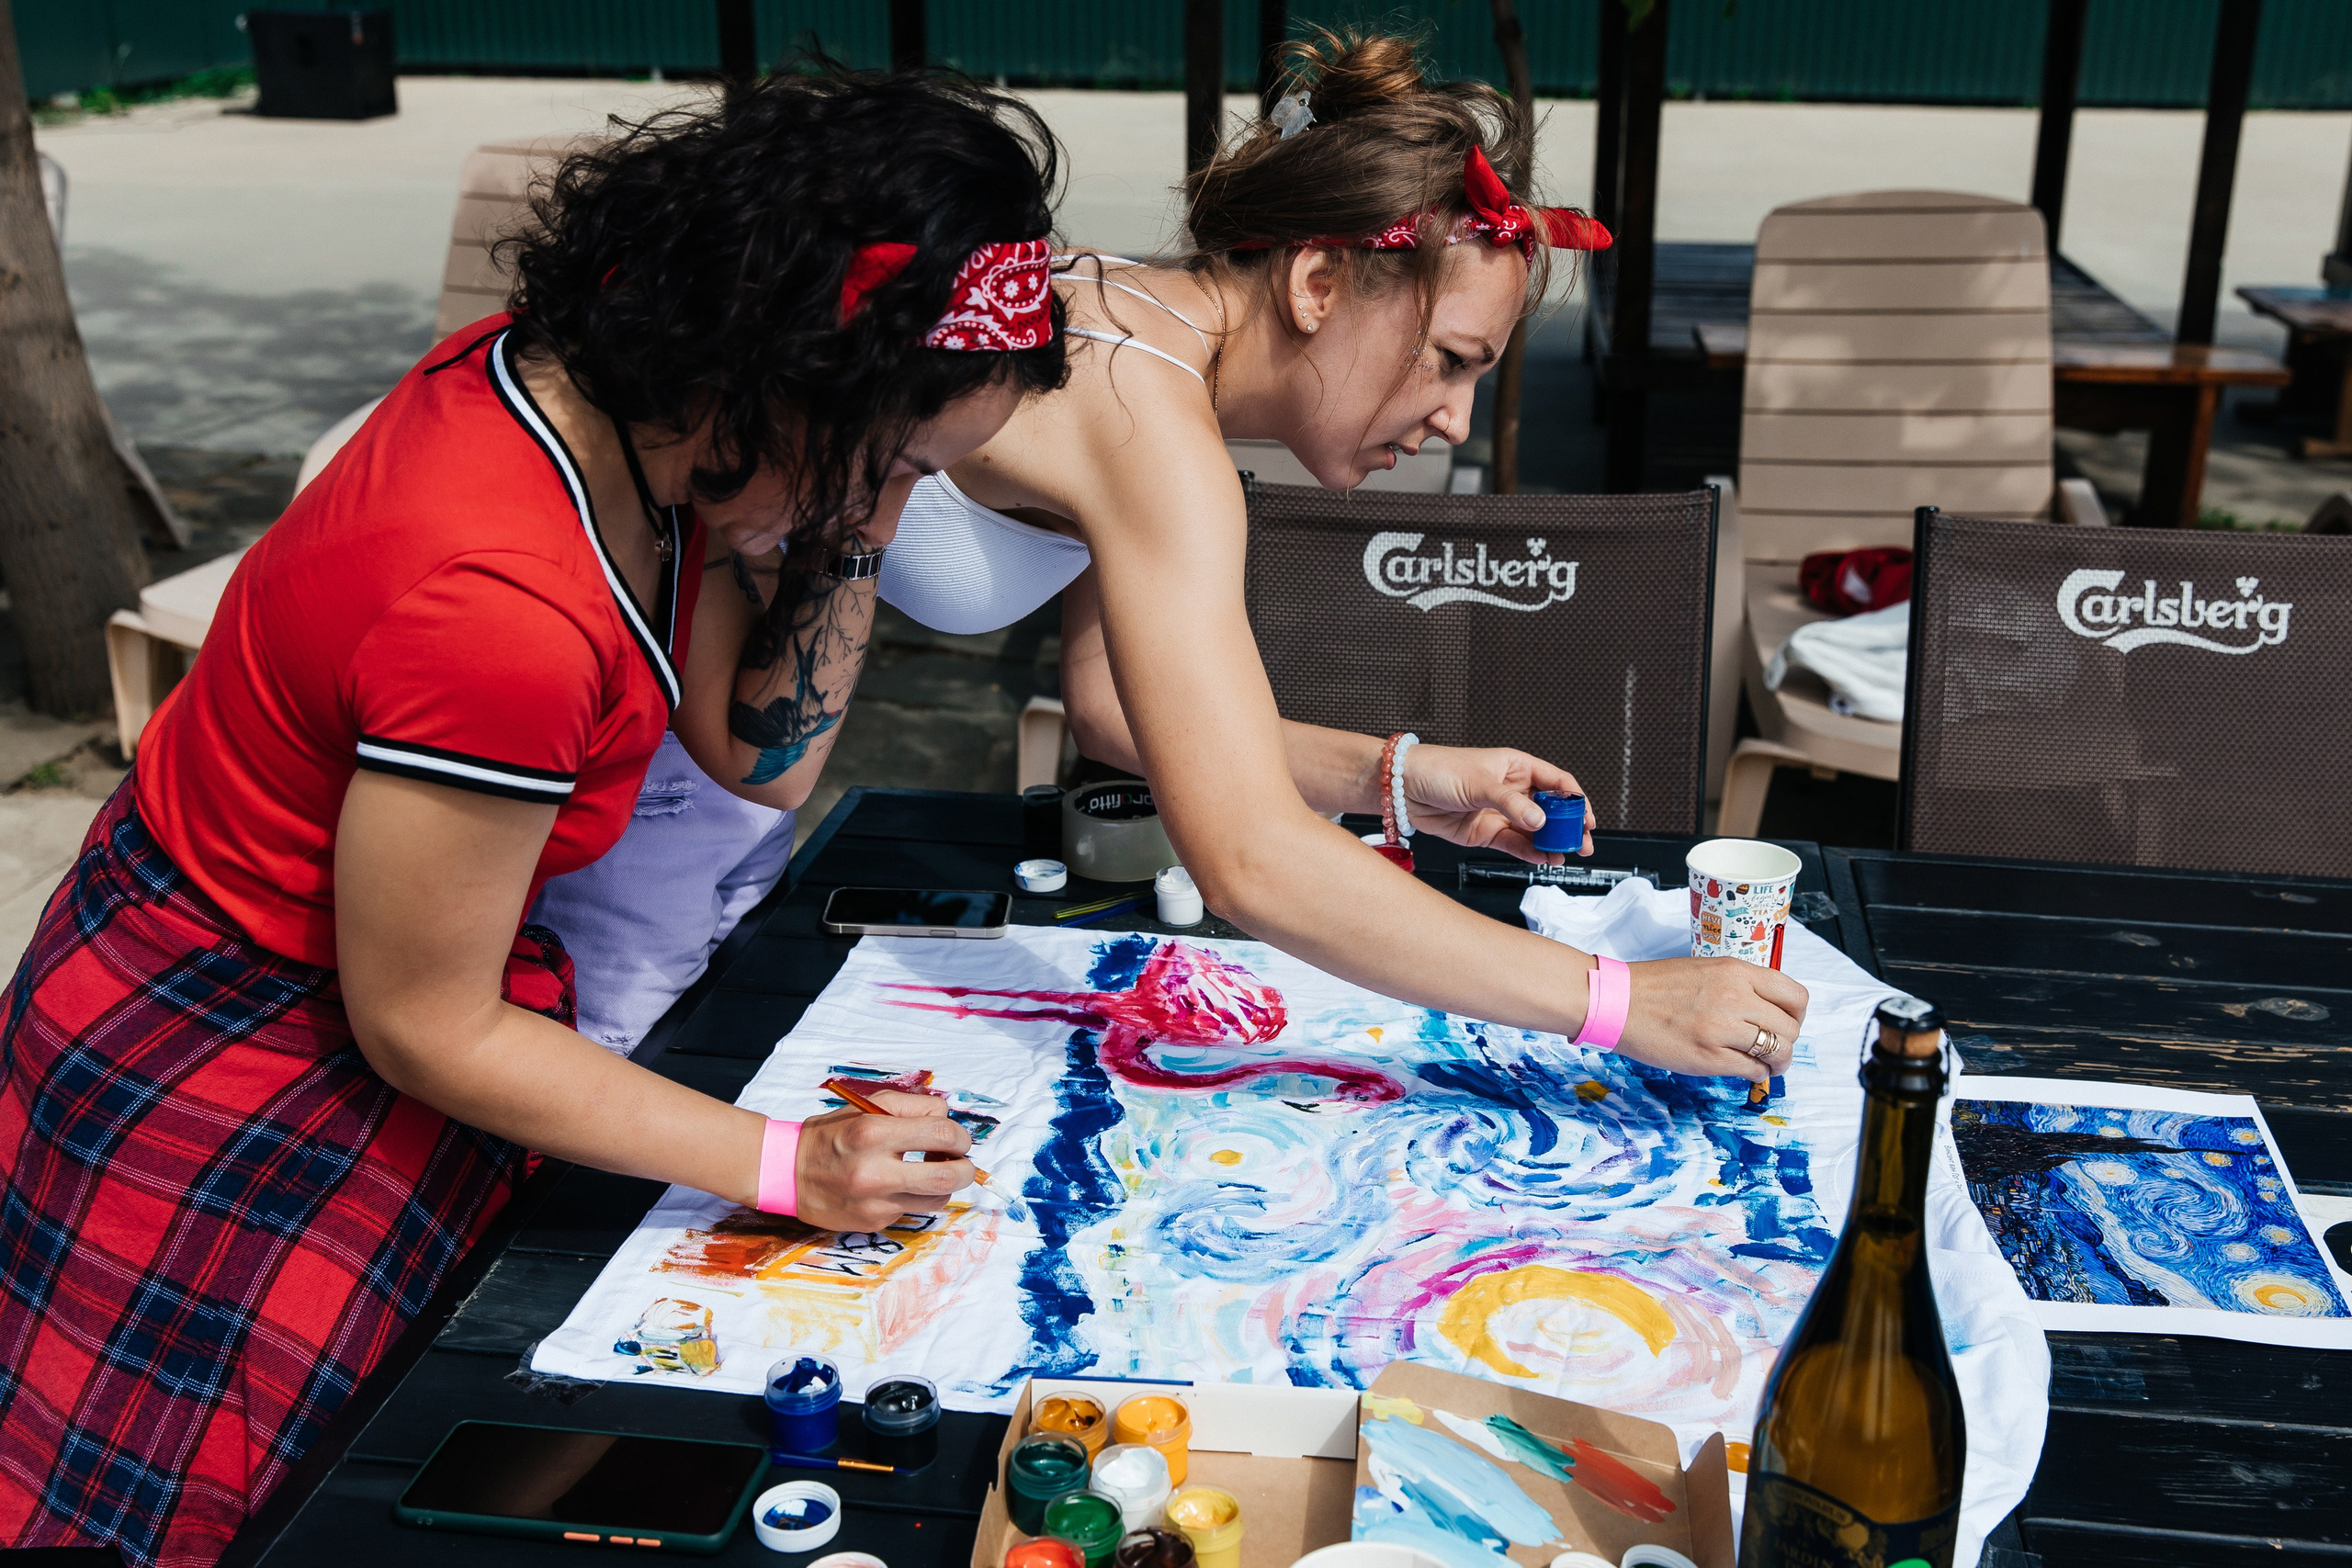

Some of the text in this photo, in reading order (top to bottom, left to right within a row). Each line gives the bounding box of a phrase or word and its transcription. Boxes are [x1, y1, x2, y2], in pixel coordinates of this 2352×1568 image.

[1363, 531, 1579, 612] Carlsberg
[2057, 569, 2293, 655] Carlsberg
[1753, 886, 1773, 895] LIFE
[1703, 923, 1722, 934] nice
[1703, 931, 1722, 942] DAY
